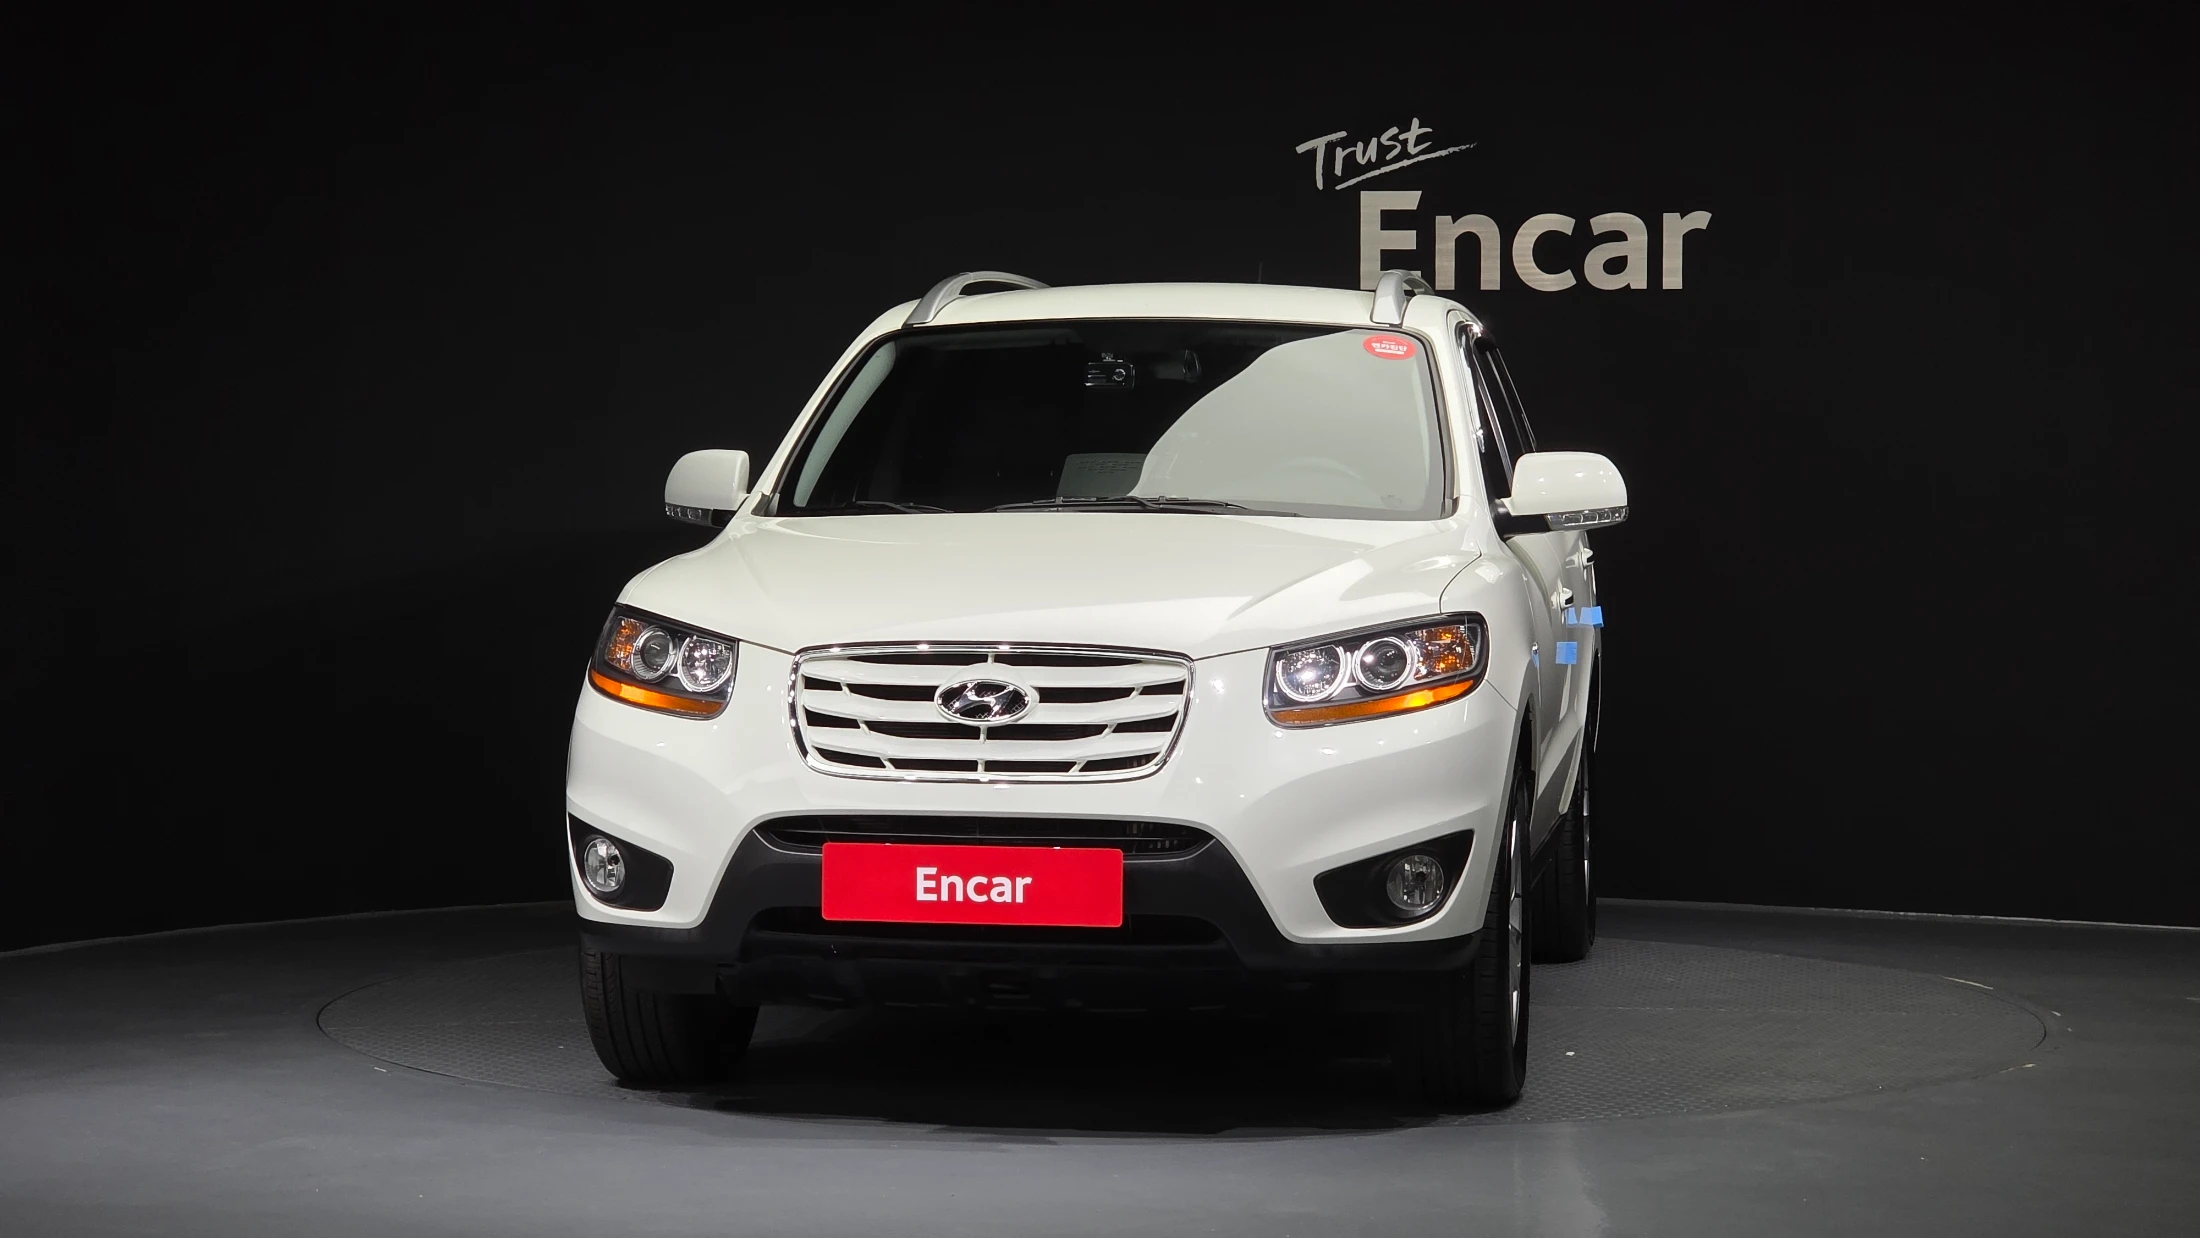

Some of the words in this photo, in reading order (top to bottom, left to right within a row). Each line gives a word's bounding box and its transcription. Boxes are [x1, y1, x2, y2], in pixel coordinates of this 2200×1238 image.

[1296, 117, 1433, 190] Trust
[1360, 190, 1713, 292] Encar
[916, 866, 1033, 903] Encar
